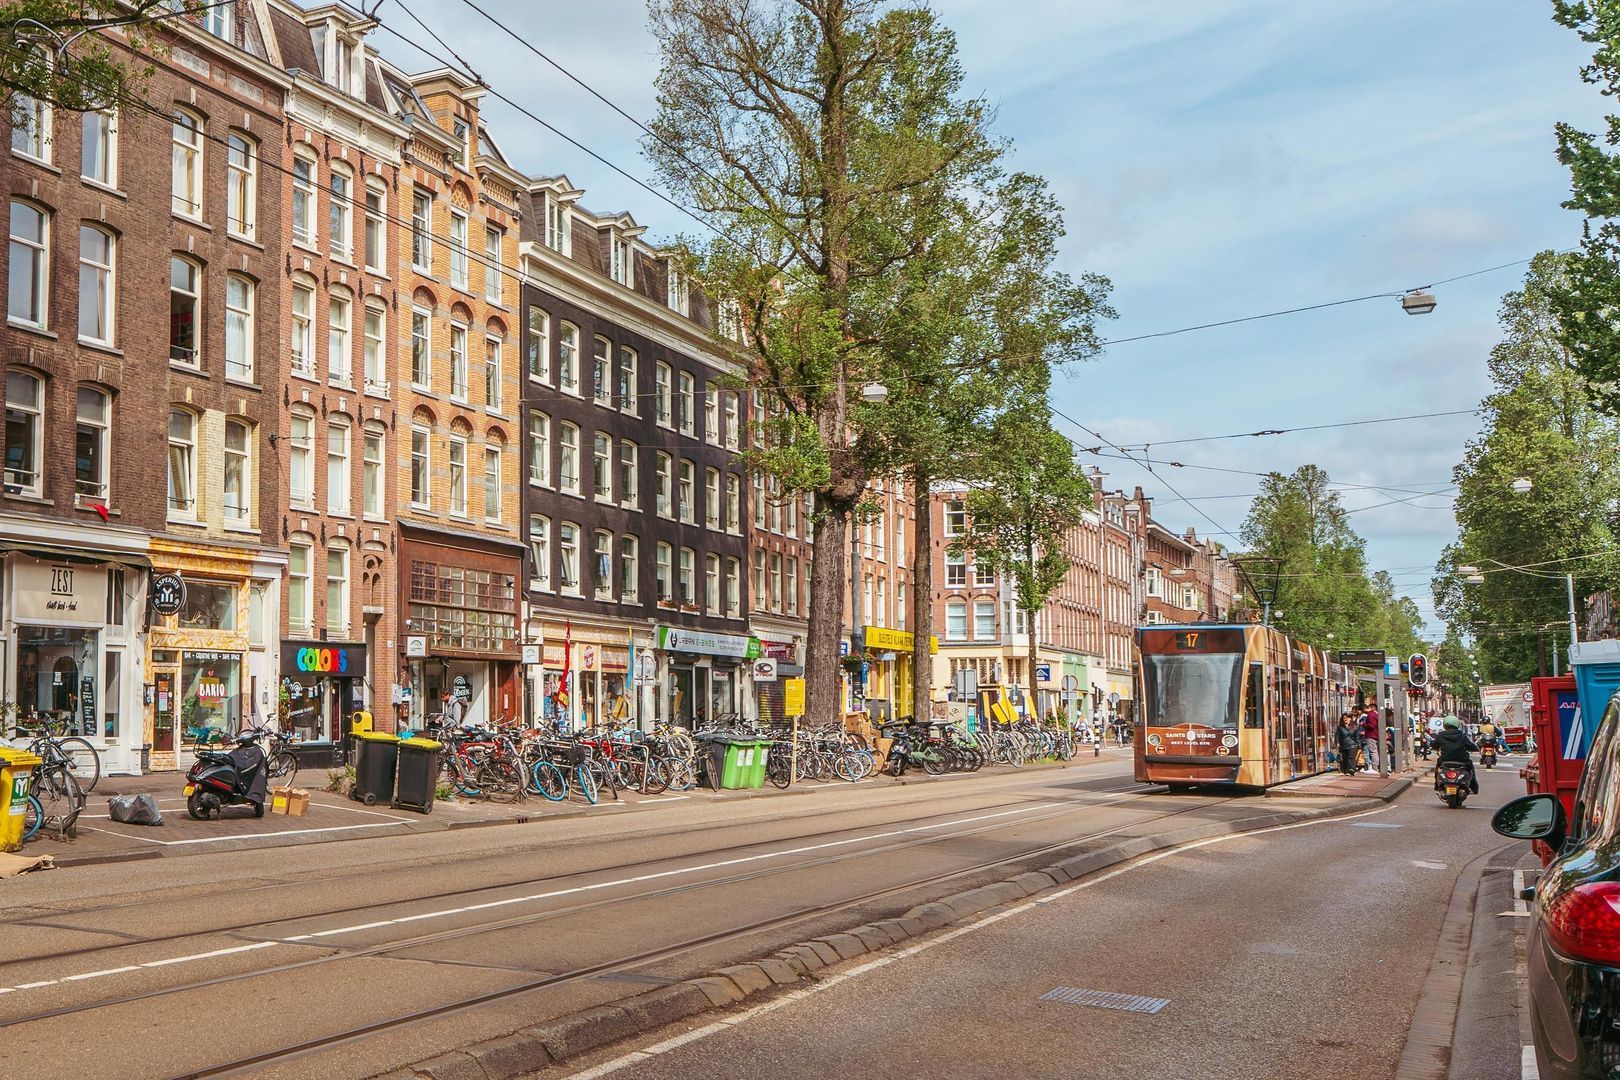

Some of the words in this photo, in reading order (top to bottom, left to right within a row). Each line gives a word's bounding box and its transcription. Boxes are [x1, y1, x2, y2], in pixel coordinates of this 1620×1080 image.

[51, 569, 74, 593] ZEST
[1186, 633, 1199, 648] 17
[297, 647, 348, 673] COLORS
[200, 683, 225, 697] BARIO
